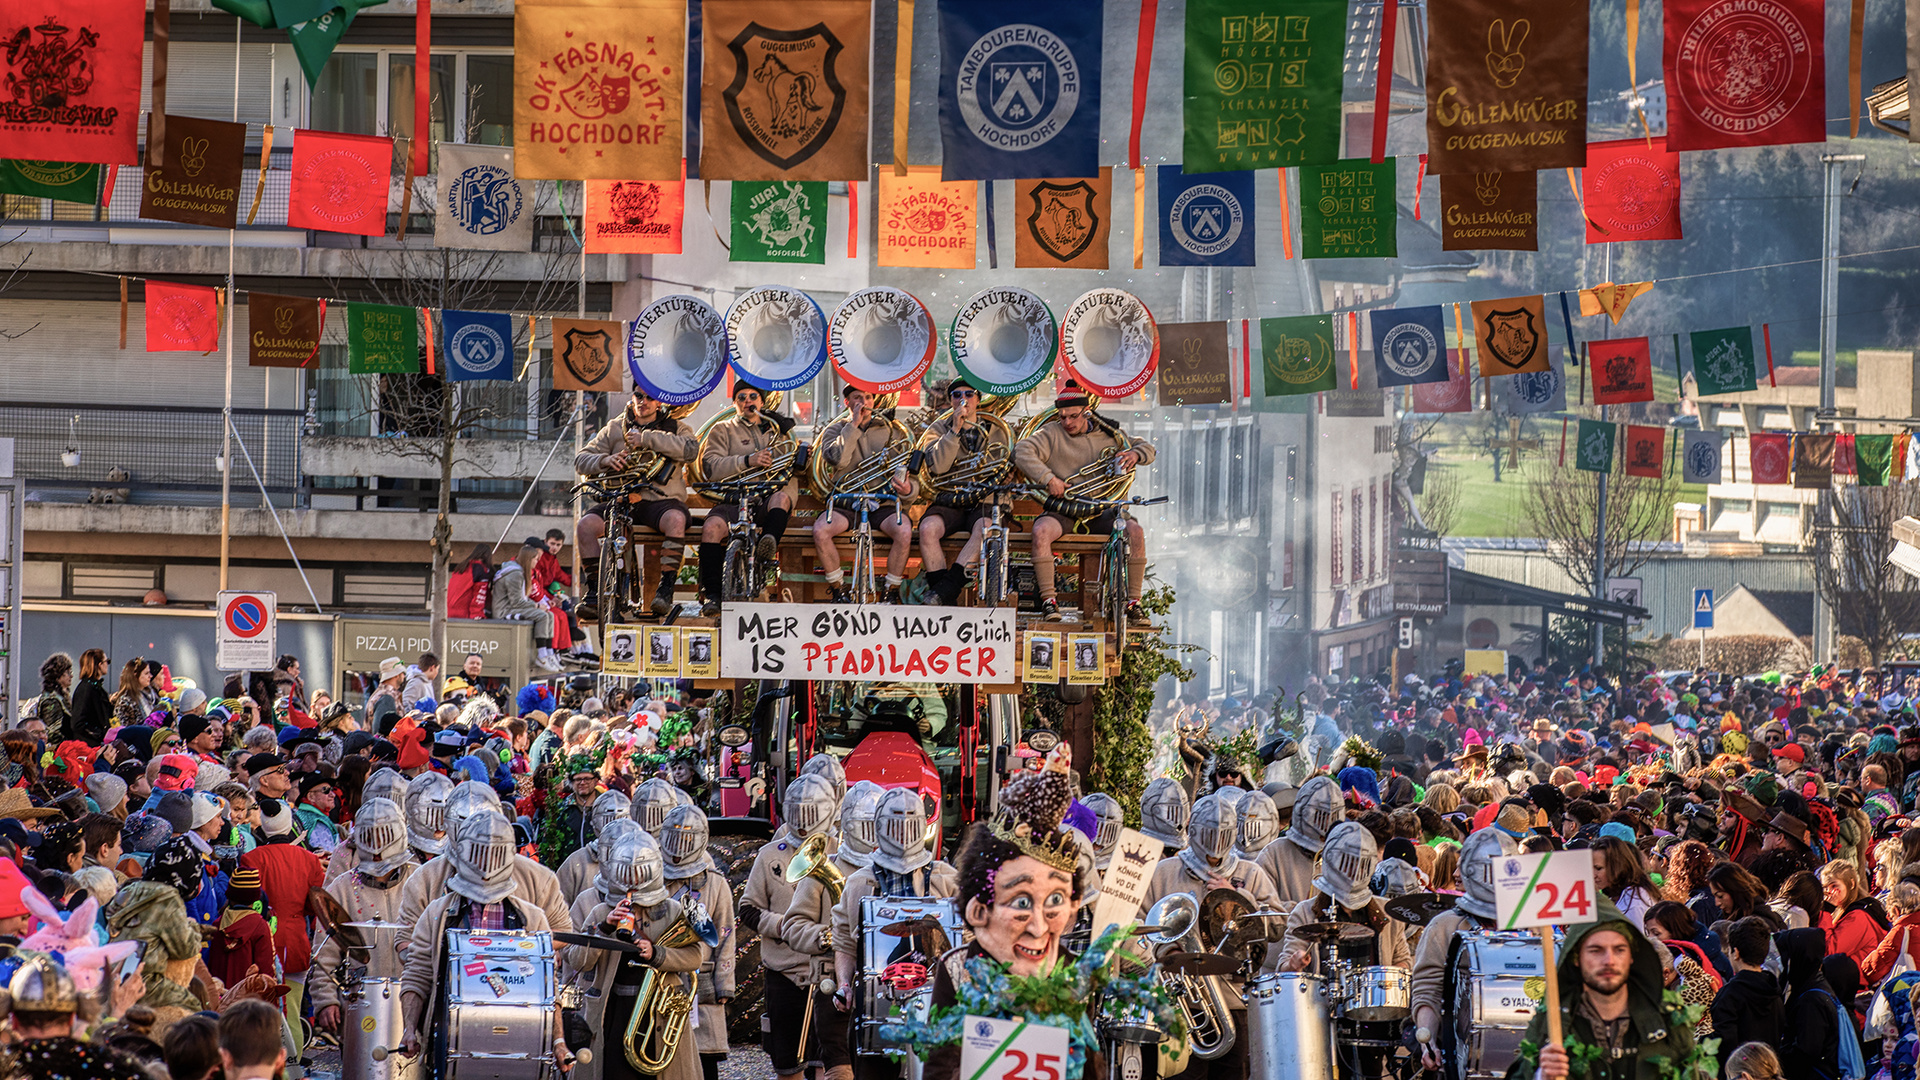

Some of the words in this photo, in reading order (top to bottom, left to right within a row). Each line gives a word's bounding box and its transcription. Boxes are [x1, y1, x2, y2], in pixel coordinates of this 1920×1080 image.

[760, 39, 816, 53] GUGGEMUSIG
[960, 28, 1077, 94] TAMBOURENGRUPPE
[528, 74, 557, 111] OK
[553, 42, 665, 112] FASNACHT
[1220, 99, 1310, 111] SCHRÄNZER
[1700, 100, 1787, 131] HOCHDORF
[530, 122, 666, 144] HOCHDORF
[742, 106, 780, 150] ROSSBOMELE
[797, 116, 825, 145] HOFDERE
[978, 118, 1057, 147] HOCHDORF
[1445, 129, 1568, 151] GUGGENMUSIK
[152, 197, 229, 214] GUGGENMUSIK
[748, 184, 780, 210] JURI
[1171, 184, 1242, 224] TAMBOURENGRUPPE
[312, 204, 364, 223] HOCHDORF
[888, 209, 905, 229] OK
[901, 191, 966, 231] FASNACHT
[1453, 228, 1528, 239] GUGGENMUSIK
[1608, 213, 1661, 232] HOCHDORF
[888, 235, 967, 249] HOCHDORF
[1184, 236, 1232, 254] HOCHDORF
[462, 360, 498, 372] HOCHDORF
[1395, 602, 1443, 612] RESTAURANT
[738, 612, 799, 641] MER
[811, 608, 882, 638] GÖND
[893, 615, 953, 640] HAUT
[356, 636, 397, 652] PIZZA
[408, 637, 432, 653] PID
[451, 640, 500, 655] KEBAP
[1117, 865, 1143, 881] KÖNIGE
[1126, 881, 1136, 891] DE
[1535, 879, 1592, 919] 24
[1002, 1049, 1061, 1080] 25
